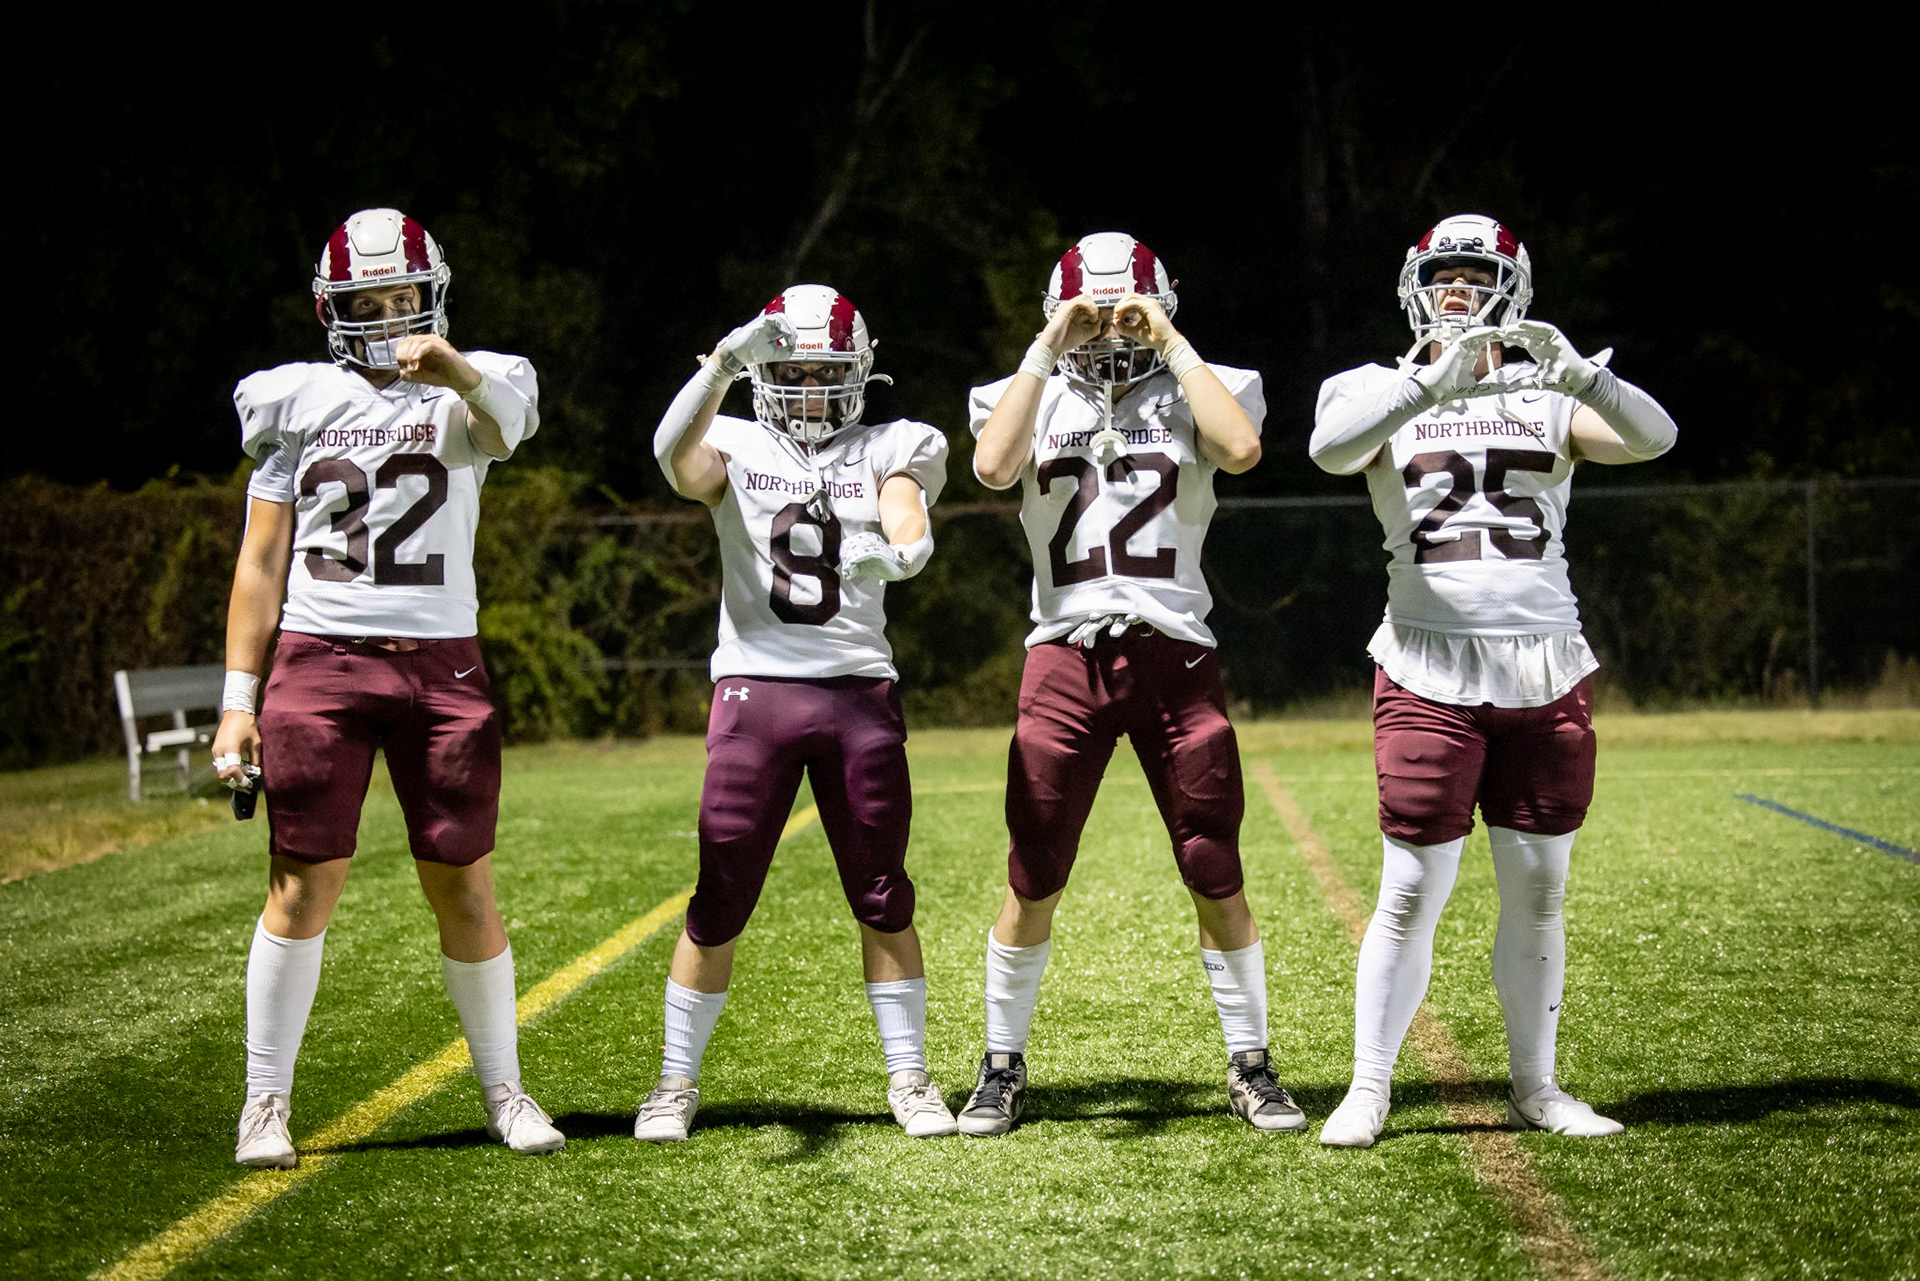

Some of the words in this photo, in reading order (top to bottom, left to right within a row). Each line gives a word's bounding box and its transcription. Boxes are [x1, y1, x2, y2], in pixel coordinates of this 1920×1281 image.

[362, 266, 396, 277] Riddell
[1092, 286, 1126, 295] Riddell
[796, 342, 823, 350] iddell
[315, 424, 436, 447] NORTHBRIDGE
[1048, 428, 1172, 449] NORTRIDGE
[1415, 421, 1546, 441] NORTHBRIDGE
[1402, 448, 1556, 565] 25
[300, 453, 449, 585] 32
[1037, 452, 1180, 588] 22
[769, 503, 842, 626] 8
